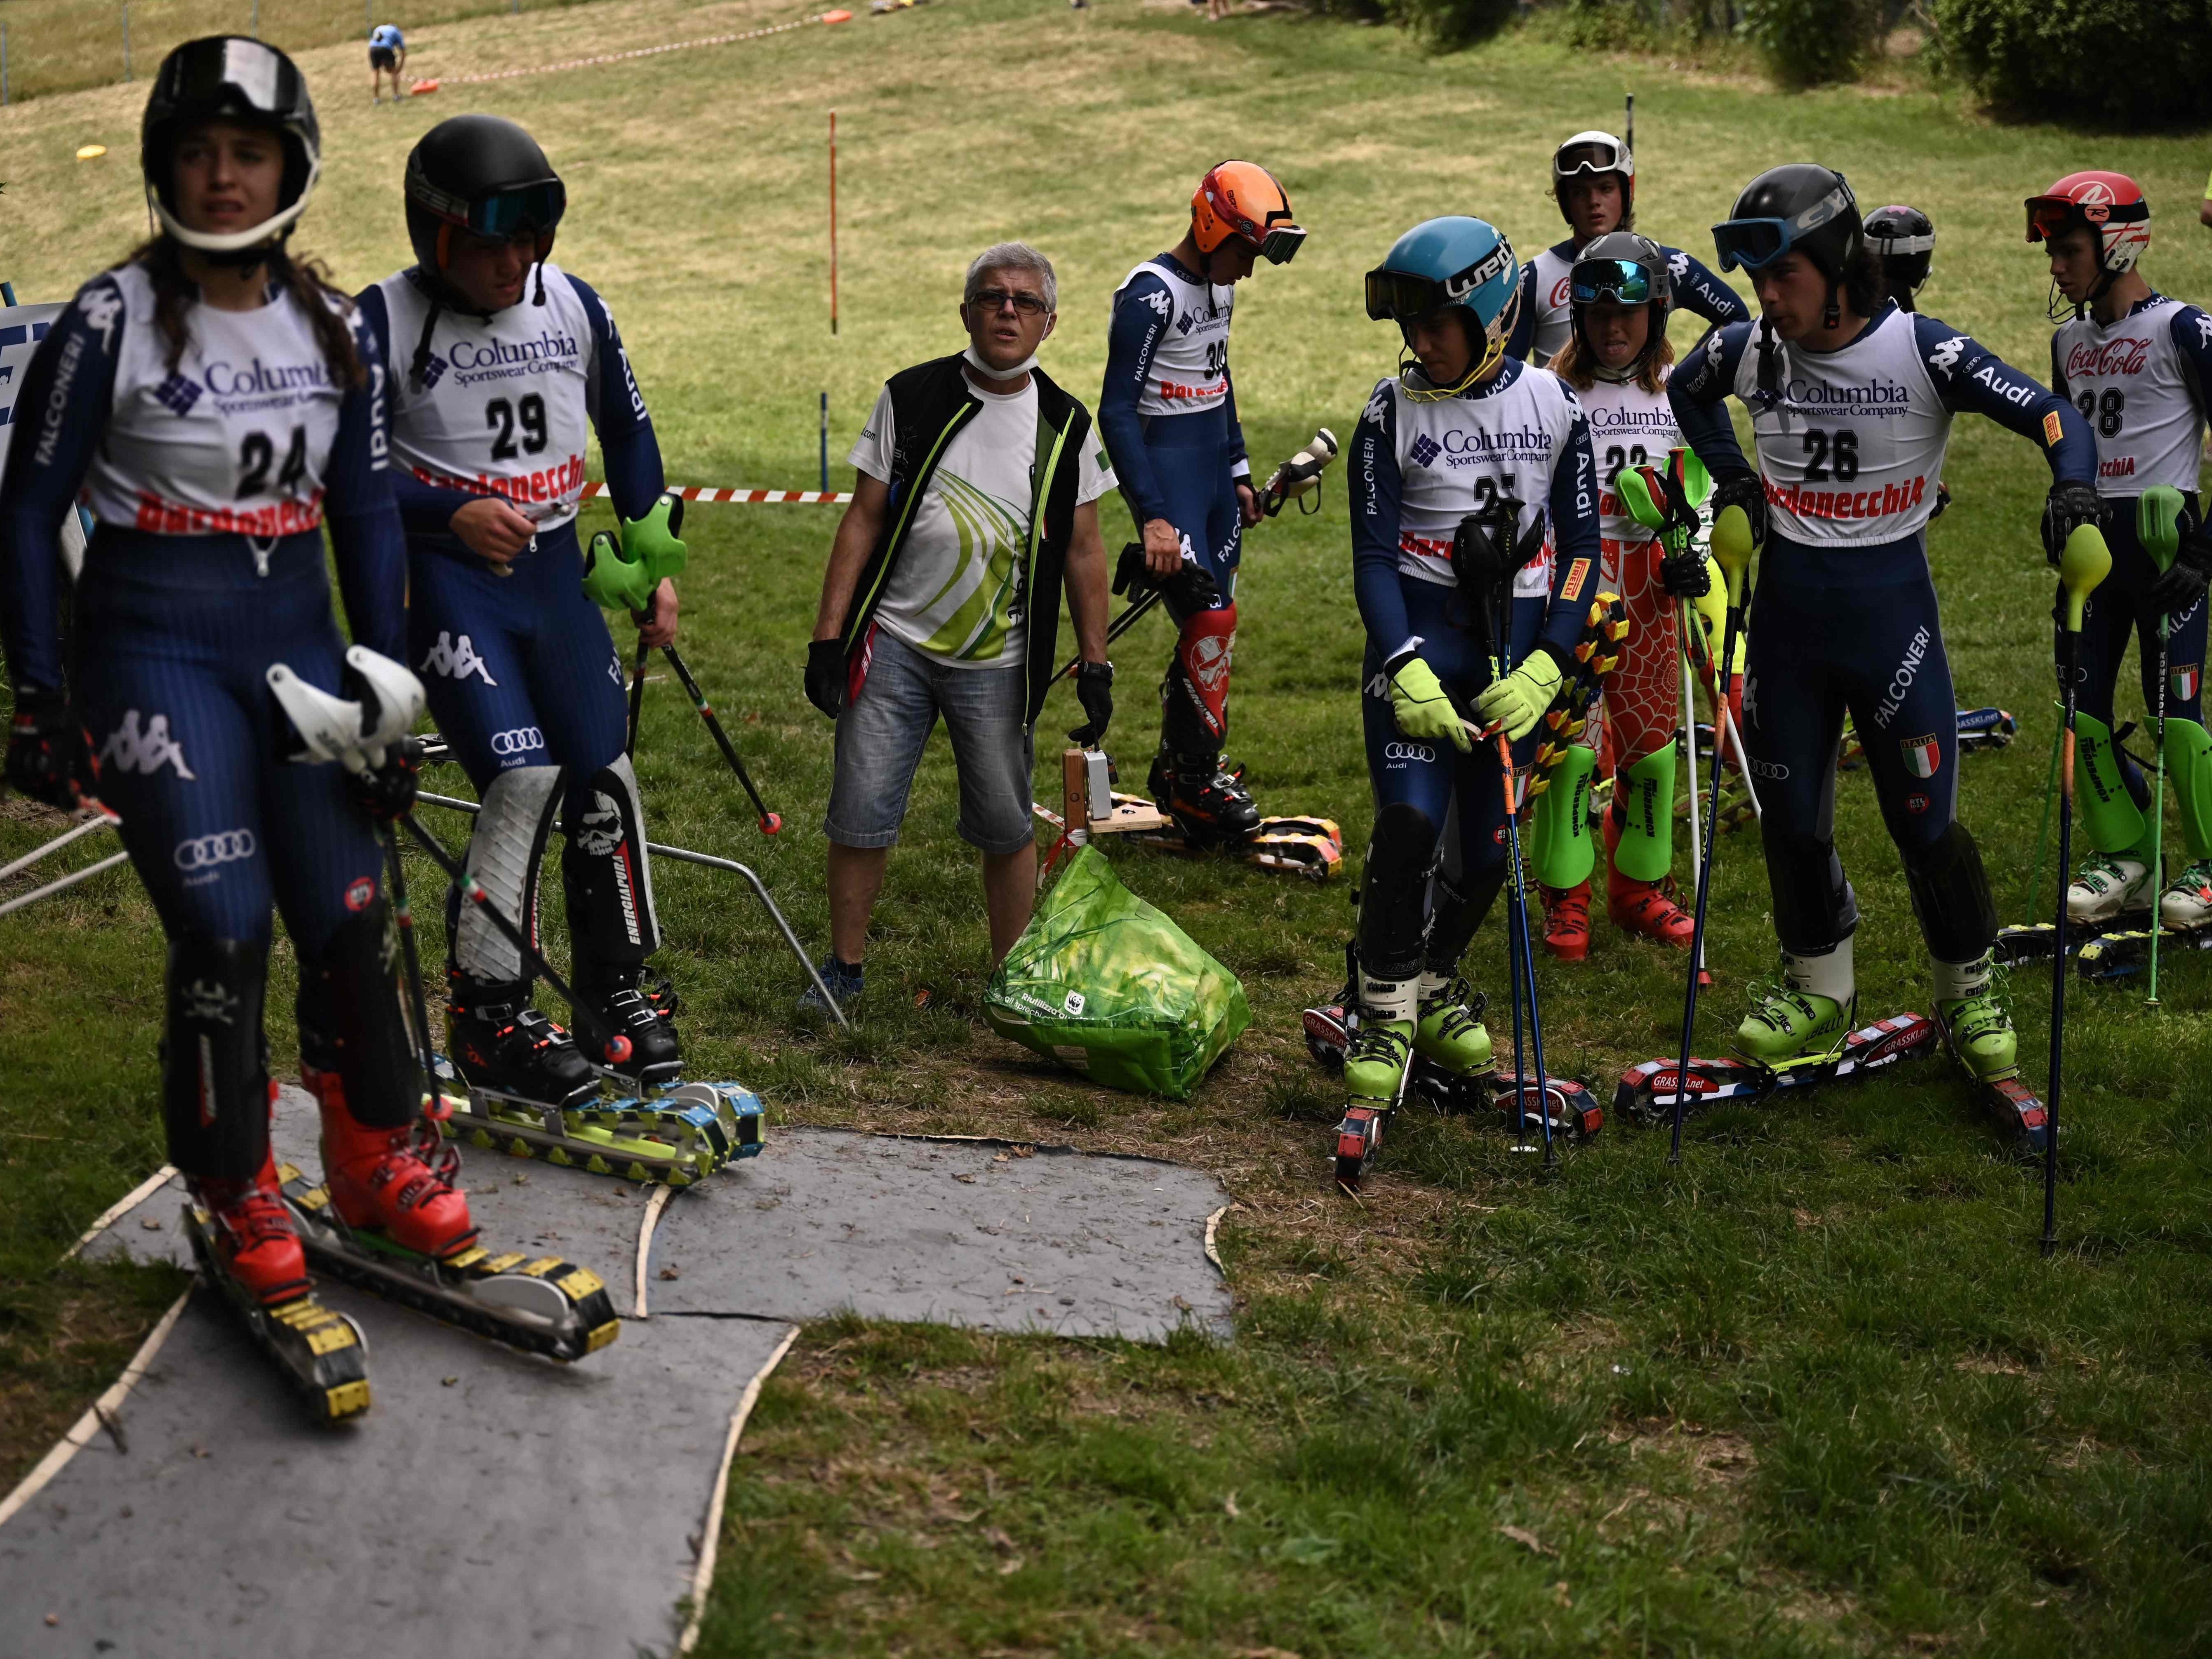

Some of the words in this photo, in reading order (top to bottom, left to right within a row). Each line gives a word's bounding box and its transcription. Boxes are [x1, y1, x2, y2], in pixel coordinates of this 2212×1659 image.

[1696, 282, 1735, 316] Audi
[449, 330, 578, 370] Columbia
[1134, 323, 1158, 382] FALCONERI
[454, 365, 526, 388] Sportswear
[618, 347, 647, 421] Audi
[1786, 378, 1909, 404] Columbia
[1973, 366, 2037, 407] Audi
[34, 332, 85, 467] FALCONERI
[370, 363, 390, 471] Audi
[1591, 406, 1679, 428] Columbia
[1786, 403, 1848, 419] Sportswear
[1850, 403, 1910, 418] Company
[2078, 387, 2125, 438] 28
[485, 392, 548, 462] 29
[1444, 424, 1552, 454] Columbia
[1592, 427, 1640, 438] Sportswear
[2045, 414, 2059, 443] PIRELLI
[235, 424, 307, 500] 24
[1364, 437, 1377, 515] FALCONERI
[1446, 452, 1506, 469] Sportswear
[1507, 449, 1552, 464] Company
[1802, 429, 1859, 483] 26
[1576, 452, 1592, 519] Audi
[1564, 560, 1587, 597] PIRELLI
[1874, 625, 1930, 729] FALCONERI
[2173, 665, 2196, 675] ITALIA
[1903, 736, 1934, 748] ITALIA
[500, 756, 526, 769] Audi
[1572, 774, 1586, 838] KOMPERDELL
[1701, 779, 1713, 862] GIPRON
[612, 855, 641, 946] ENERGIAPURA
[1021, 992, 1058, 1015] Riutilizza
